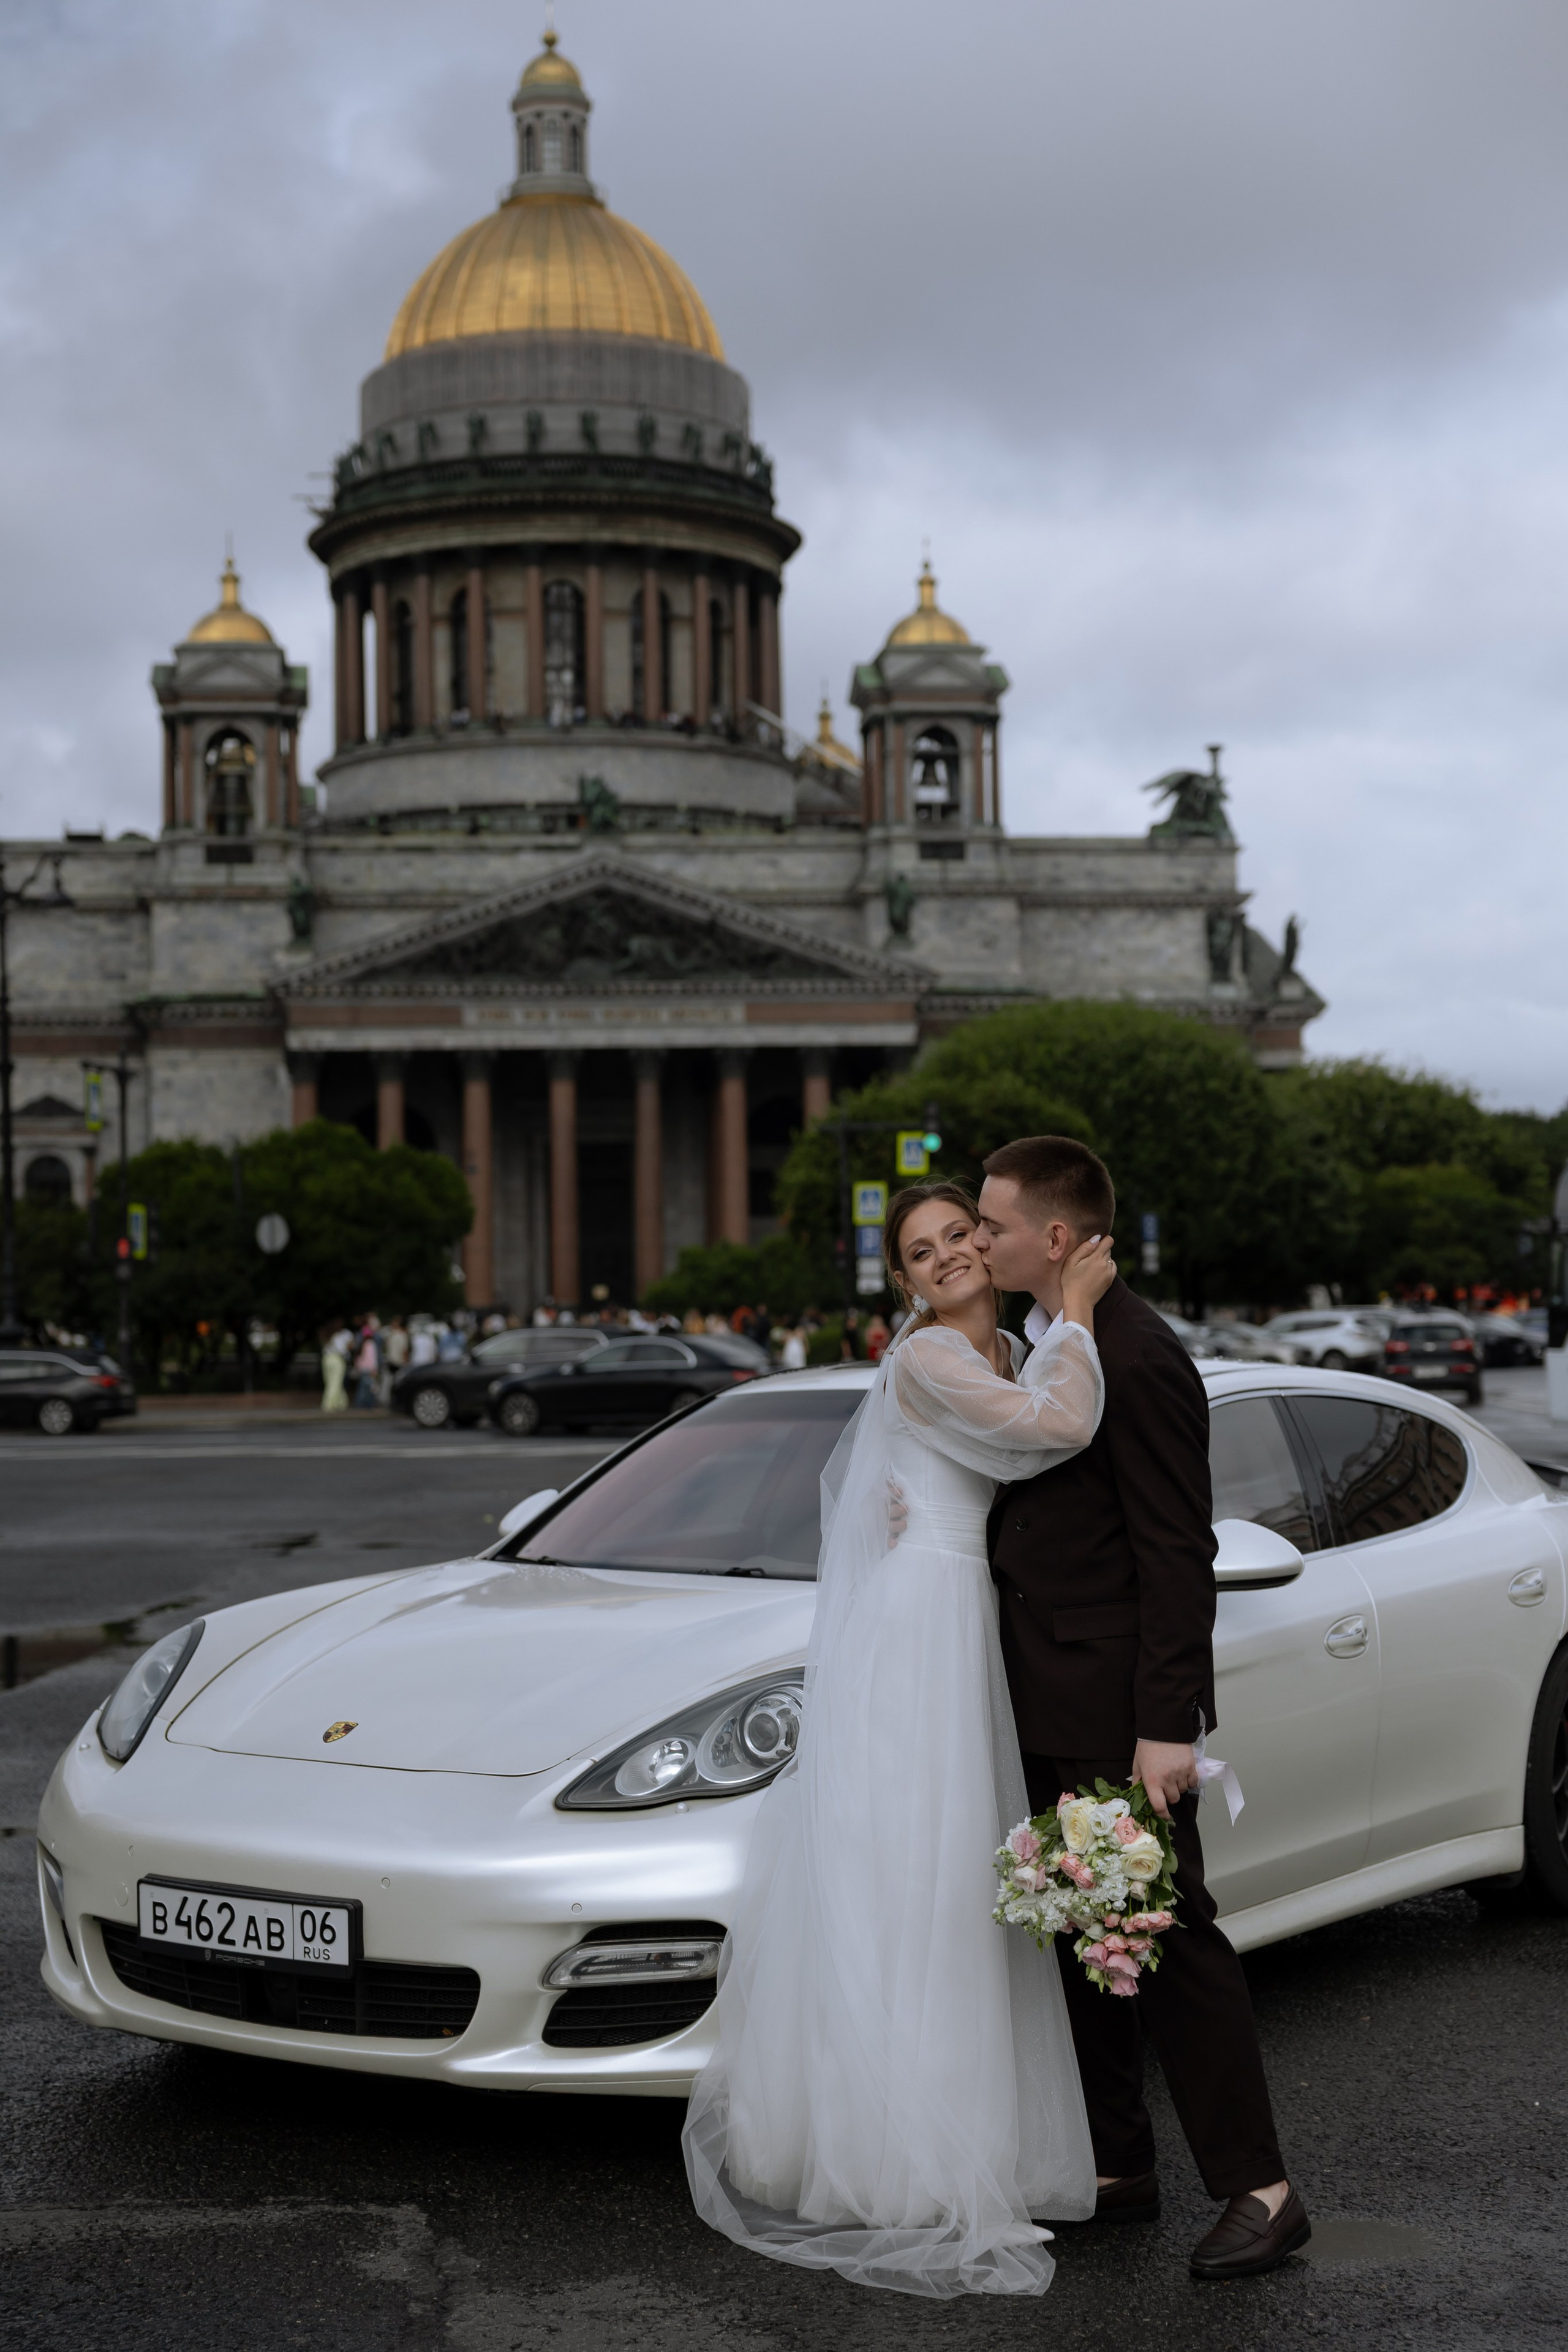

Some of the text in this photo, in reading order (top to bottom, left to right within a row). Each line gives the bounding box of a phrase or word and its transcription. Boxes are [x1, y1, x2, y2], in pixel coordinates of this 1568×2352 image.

[300, 1909, 336, 1945] 06
[216, 1953, 265, 1966] PORSCHE
[303, 1946, 331, 1961] RUS
